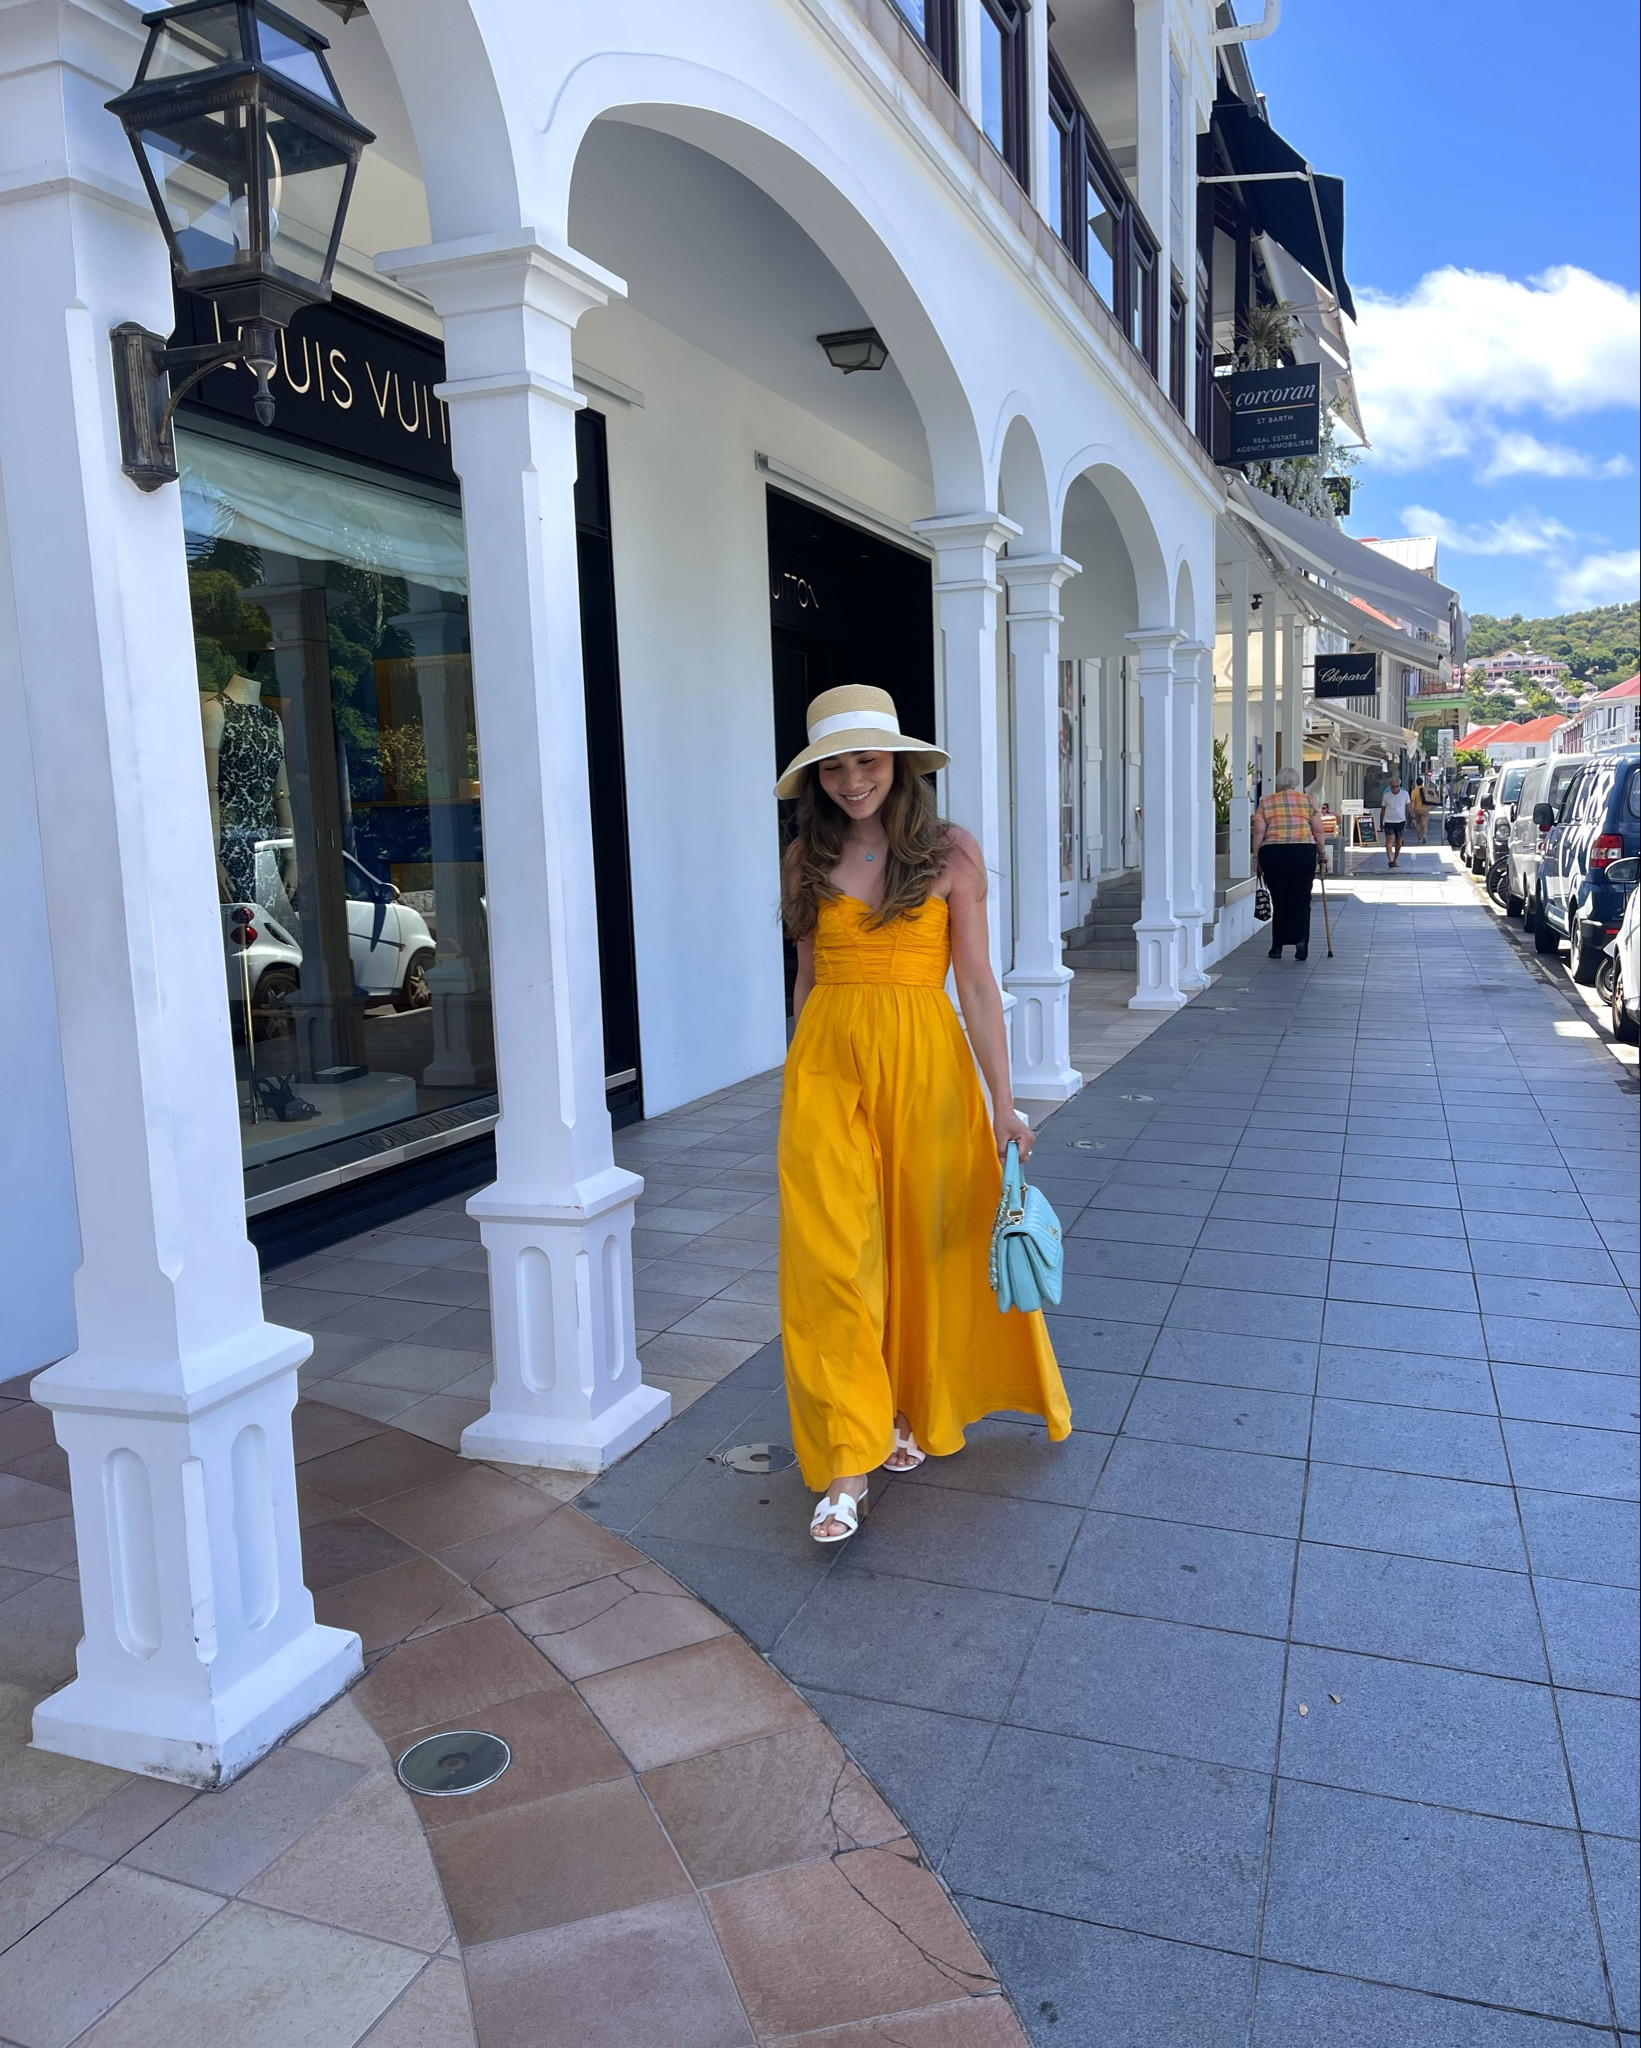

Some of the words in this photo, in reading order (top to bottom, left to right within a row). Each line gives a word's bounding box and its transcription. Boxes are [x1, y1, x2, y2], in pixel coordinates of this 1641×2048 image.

[1235, 384, 1316, 407] corcoran
[1268, 415, 1293, 424] BARTH
[1273, 434, 1297, 442] ESTATE
[1236, 445, 1265, 453] AGENCE
[1318, 667, 1373, 685] Chopard
